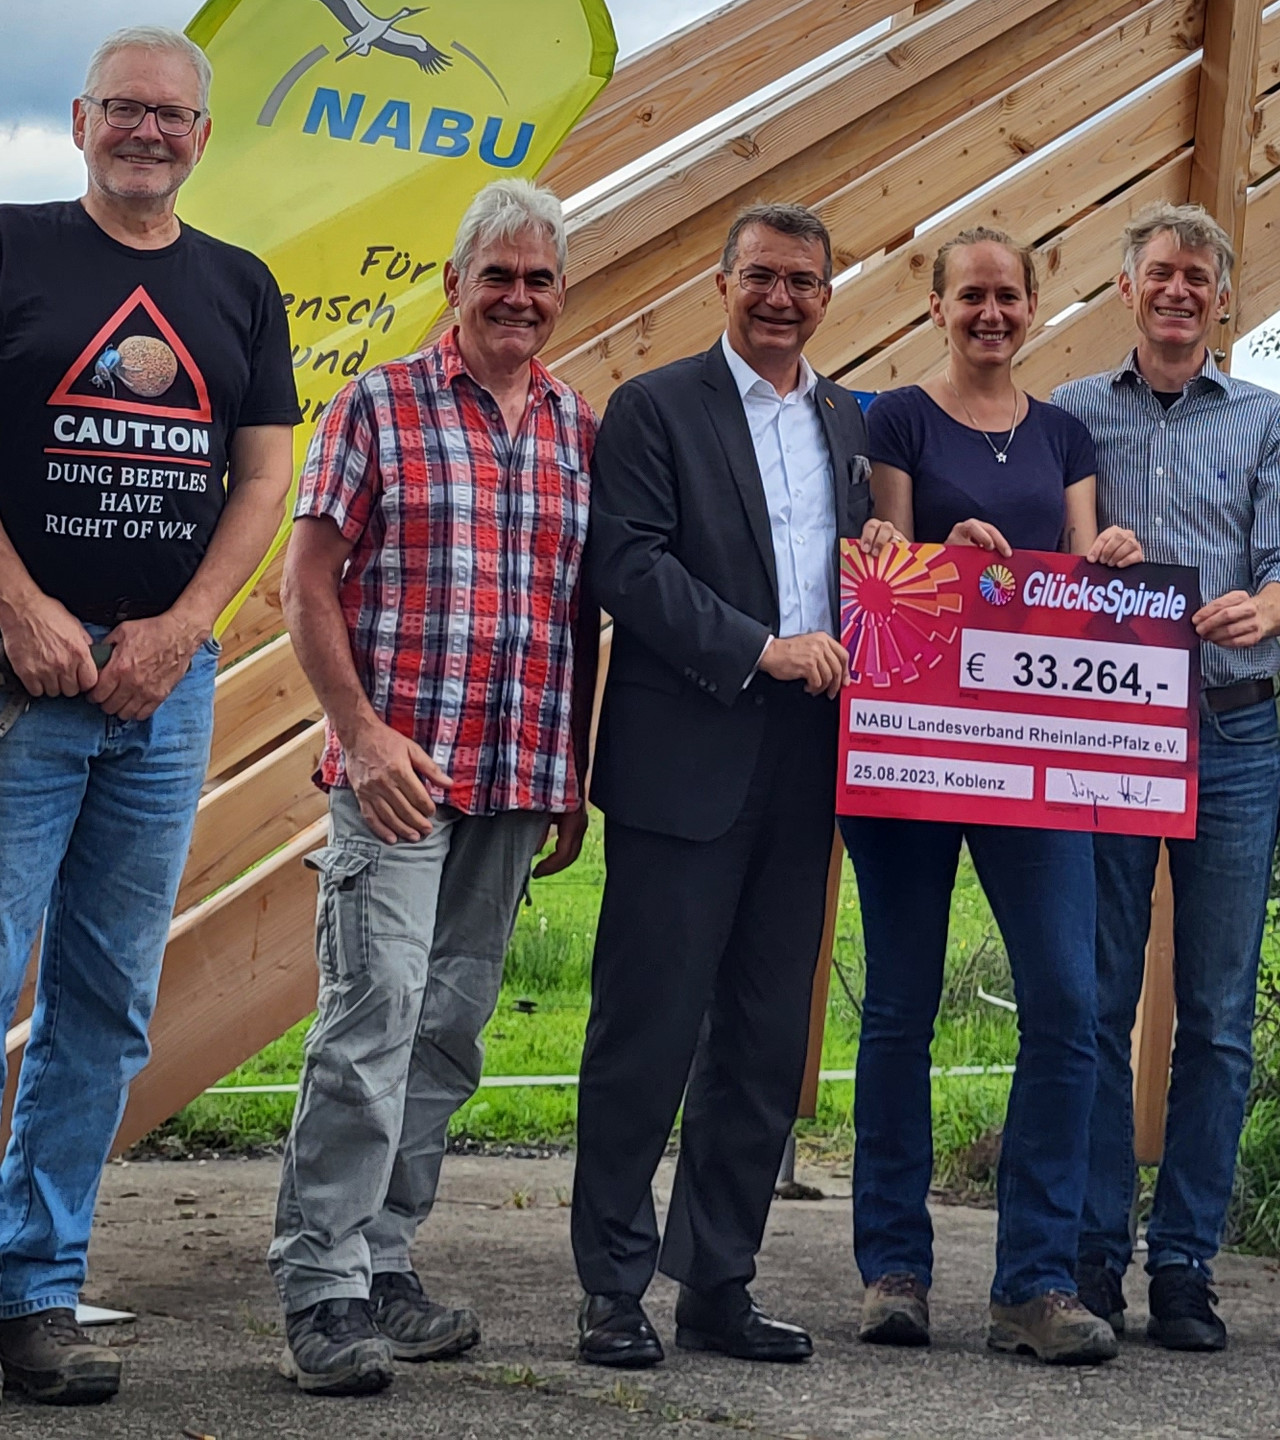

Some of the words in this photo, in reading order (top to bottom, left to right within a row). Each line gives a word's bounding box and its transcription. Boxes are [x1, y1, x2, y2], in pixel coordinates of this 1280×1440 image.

[302, 87, 535, 169] NABU
[360, 246, 437, 284] Für
[282, 292, 396, 334] ensch
[292, 339, 368, 377] und
[53, 414, 210, 455] CAUTION
[46, 462, 113, 485] DUNG
[120, 466, 207, 493] BEETLES
[99, 492, 164, 513] HAVE
[45, 513, 118, 539] RIGHT
[123, 520, 153, 539] OF
[1022, 570, 1187, 623] GlücksSpirale
[966, 652, 986, 682] €
[1013, 651, 1169, 705] 33.264,-
[856, 712, 903, 729] NABU
[908, 716, 1024, 740] Landesverband
[1029, 727, 1150, 752] Rheinland-Pfalz
[1154, 739, 1179, 754] e.V.
[853, 764, 939, 788] 25.08.2023,
[944, 771, 1005, 791] Koblenz
